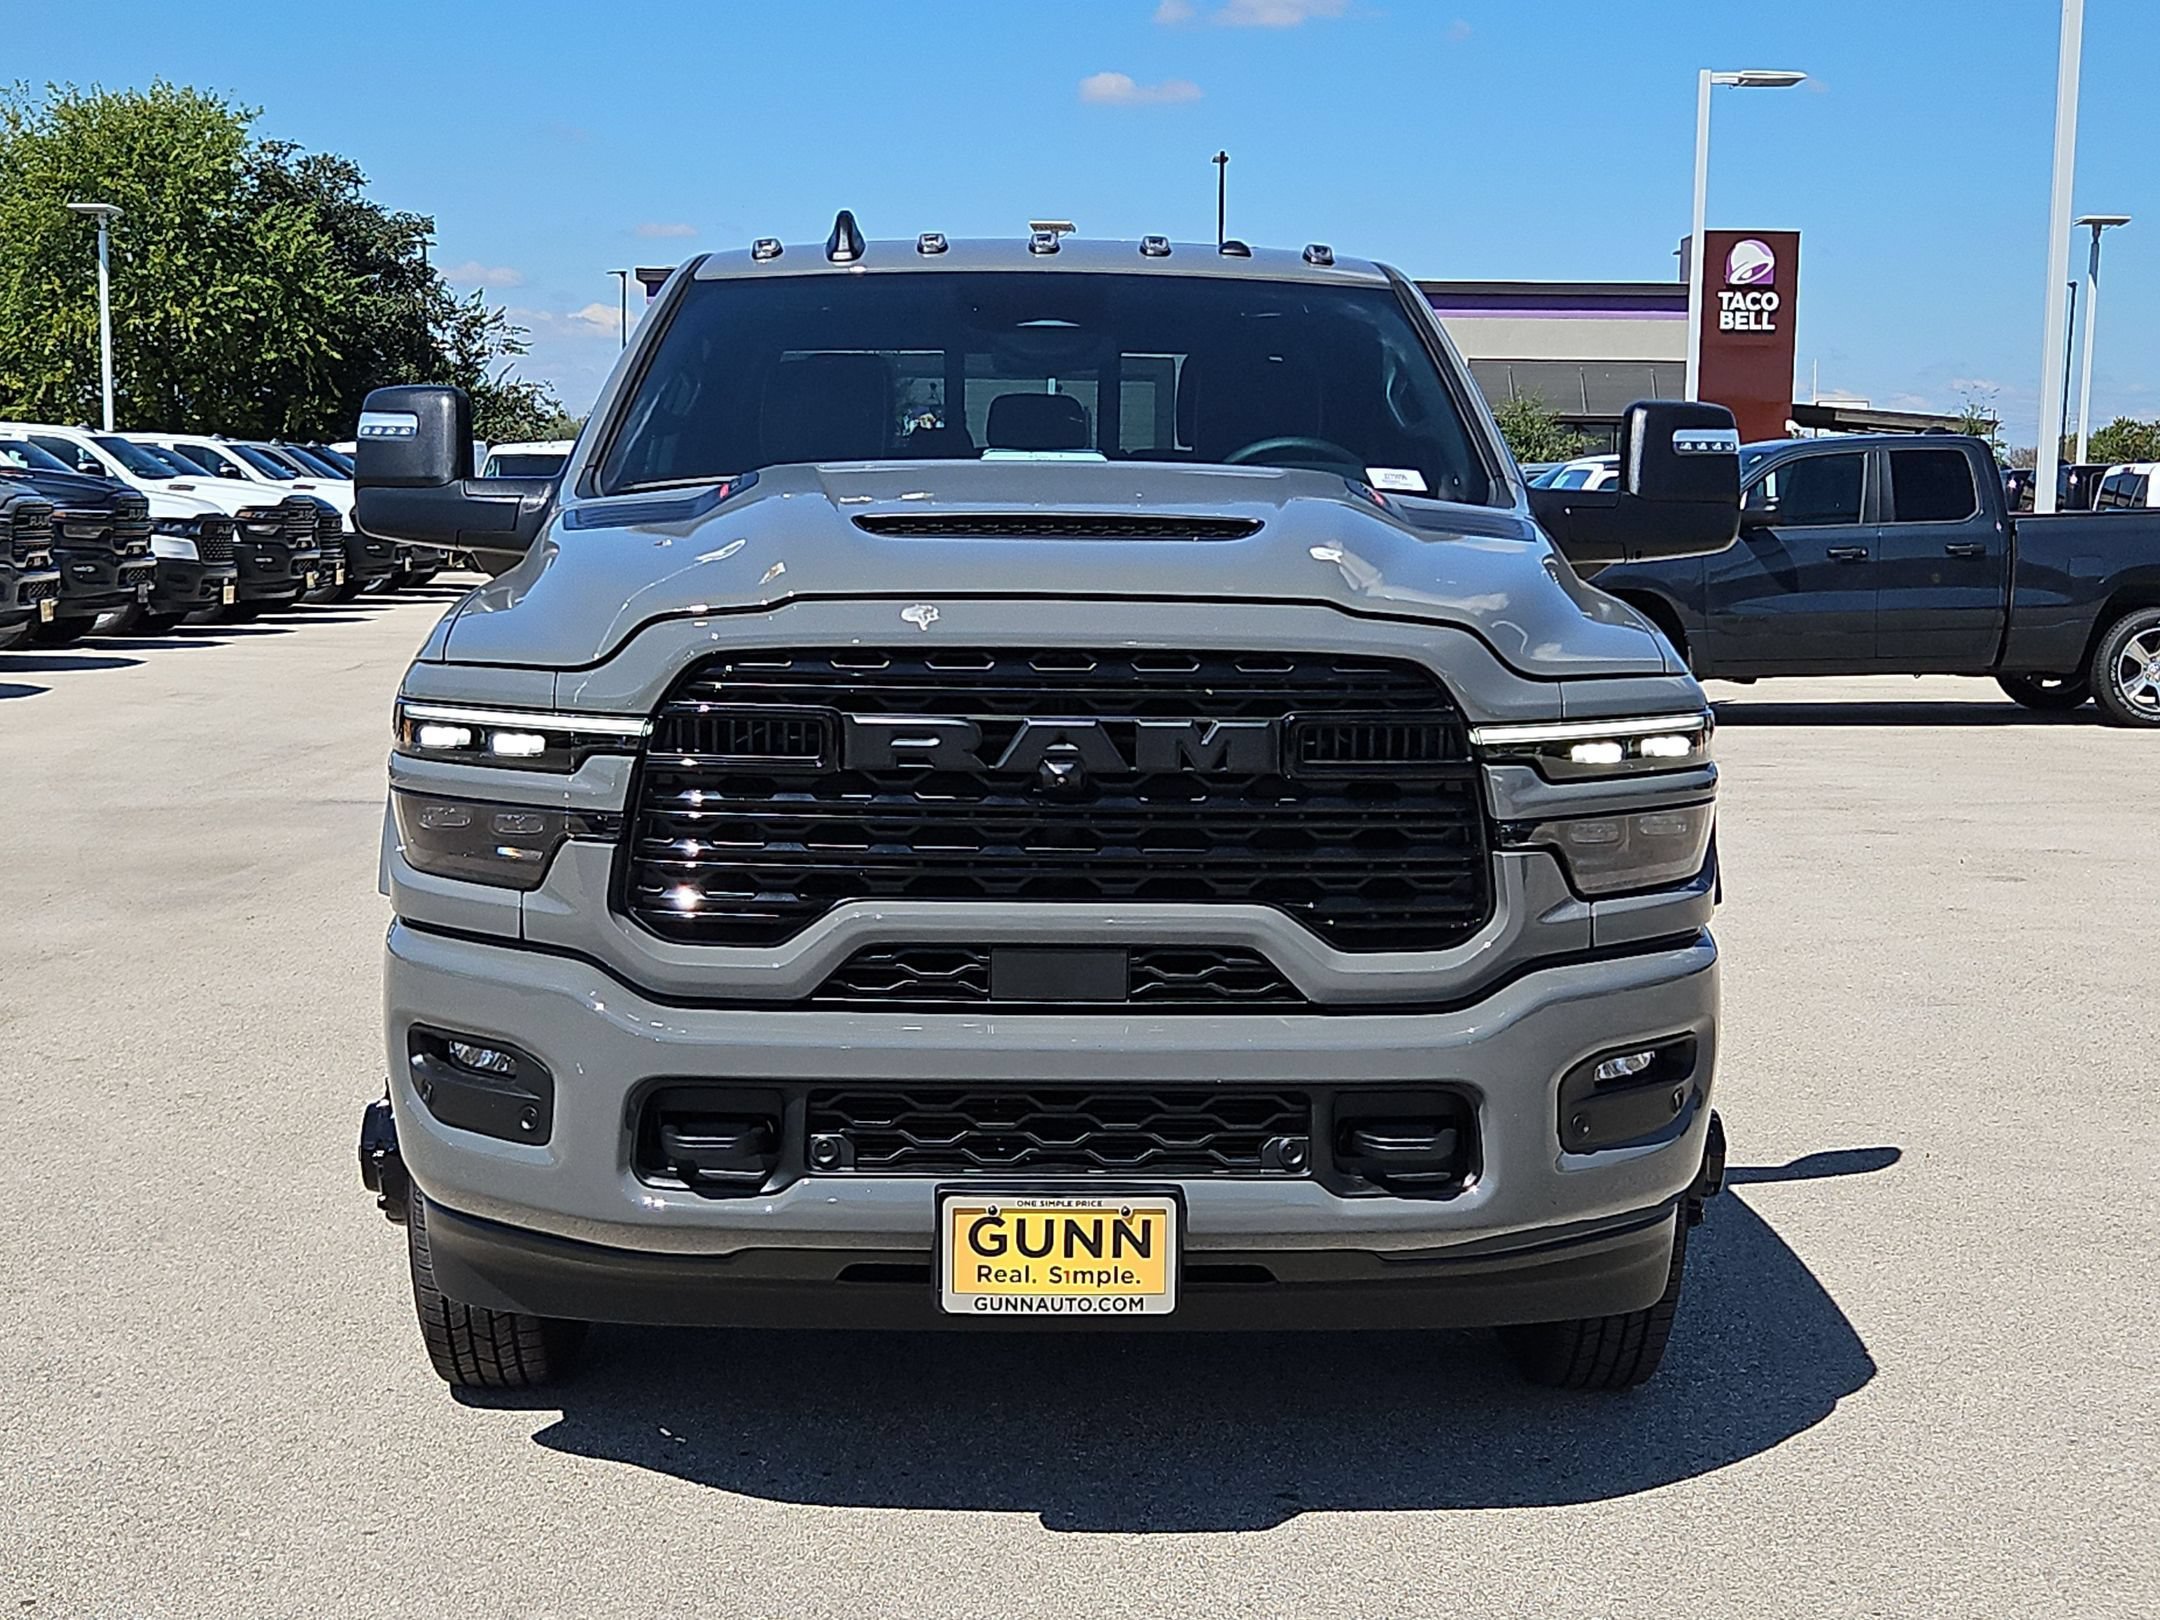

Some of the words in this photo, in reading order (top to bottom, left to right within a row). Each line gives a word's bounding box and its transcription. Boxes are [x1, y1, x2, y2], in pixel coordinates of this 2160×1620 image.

[1717, 291, 1780, 311] TACO
[1719, 311, 1776, 330] BELL
[845, 713, 1281, 773] RAM
[968, 1216, 1152, 1258] GUNN
[976, 1264, 1037, 1283] Real.
[974, 1296, 1145, 1312] GUNNAUTO.COM
